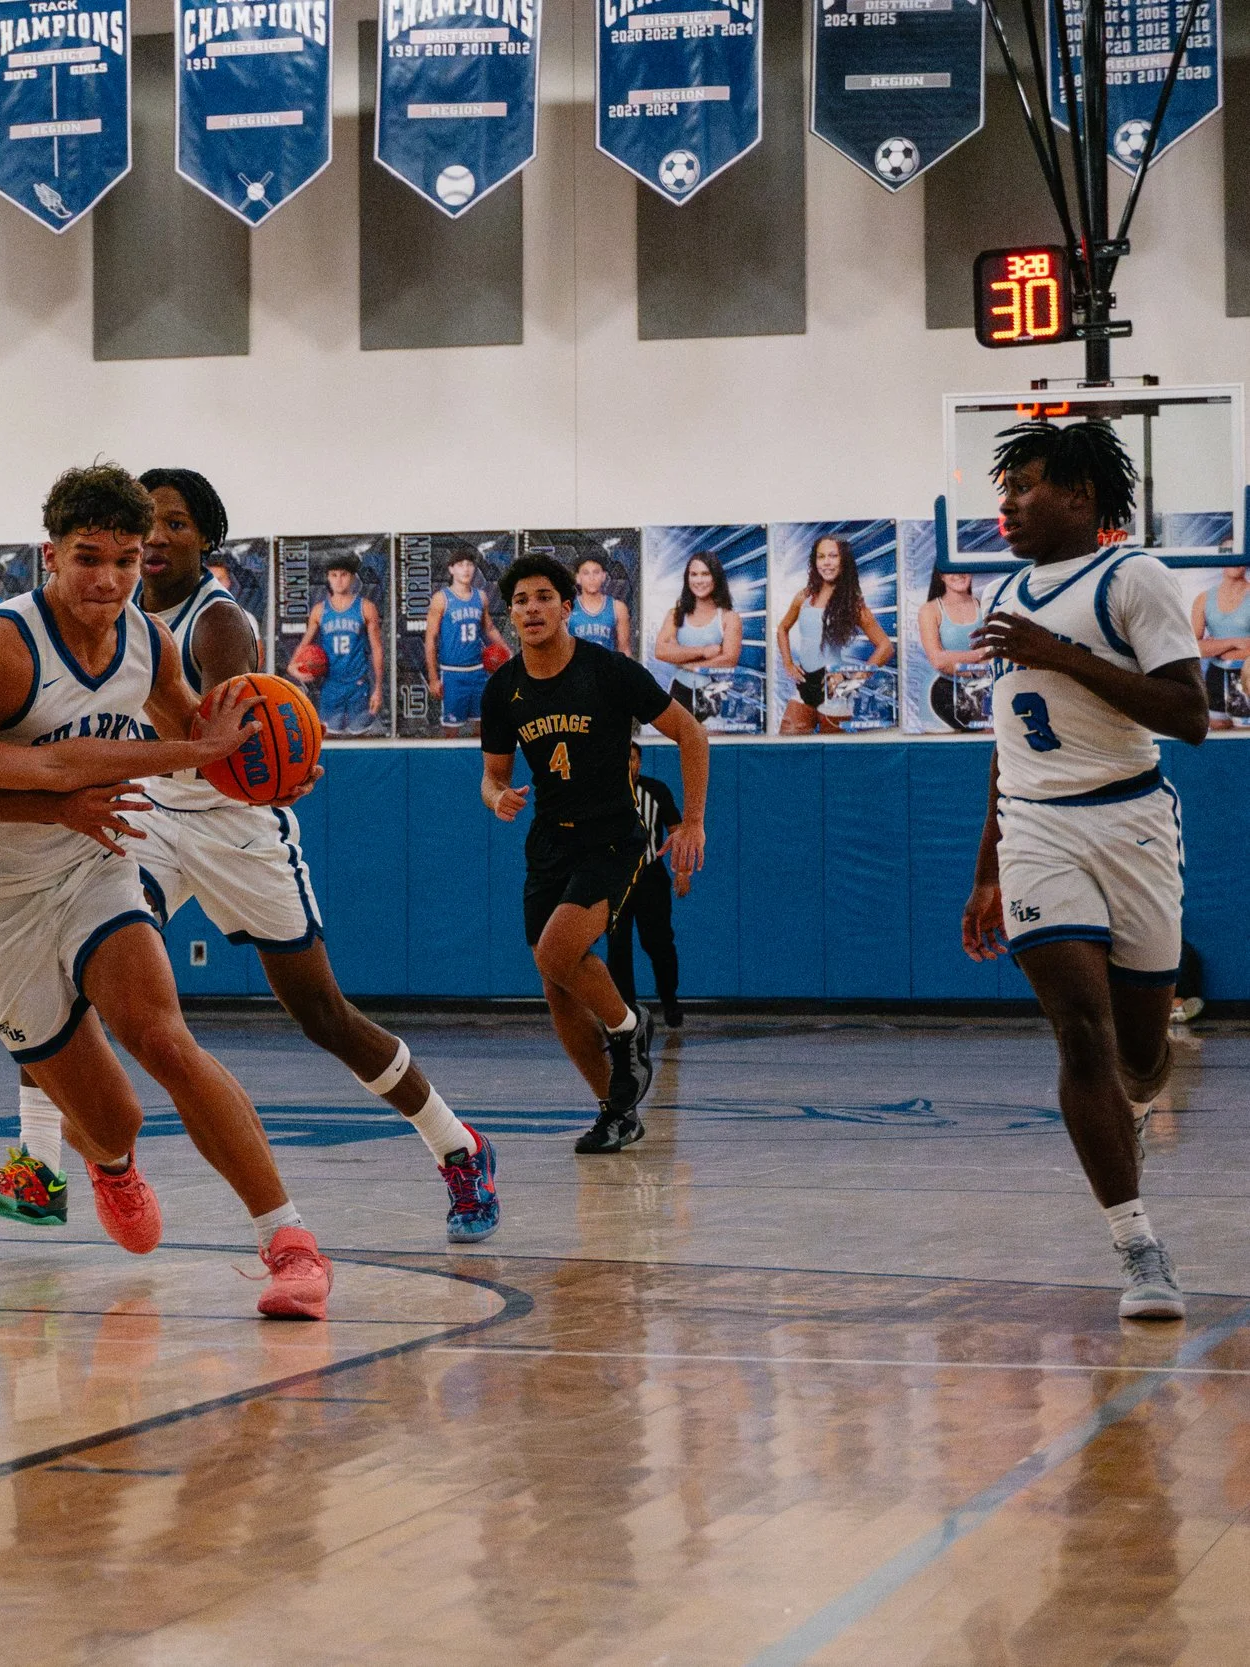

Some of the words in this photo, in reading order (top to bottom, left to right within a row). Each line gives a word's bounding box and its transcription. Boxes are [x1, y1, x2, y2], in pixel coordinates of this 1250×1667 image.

[30, 0, 78, 13] TRACK
[864, 0, 932, 10] DISTRICT
[644, 14, 712, 27] DISTRICT
[824, 14, 856, 27] 2024
[863, 12, 896, 26] 2025
[1136, 6, 1169, 22] 2005
[184, 1, 326, 55] CHAMPIONS
[611, 30, 643, 43] 2020
[645, 28, 677, 41] 2022
[683, 26, 714, 38] 2023
[720, 22, 753, 36] 2024
[1136, 22, 1170, 37] 2012
[426, 31, 492, 42] DISTRICT
[1137, 37, 1170, 52] 2022
[1186, 34, 1210, 49] 023
[222, 41, 286, 52] DISTRICT
[388, 45, 419, 58] 1991
[424, 44, 456, 56] 2010
[462, 43, 493, 55] 2011
[499, 42, 530, 54] 2012
[24, 50, 86, 63] DISTRICT
[70, 62, 108, 75] GIRLS
[186, 58, 216, 71] 1991
[4, 69, 37, 81] BOYS
[1176, 66, 1211, 80] 2020
[870, 76, 924, 87] REGION
[652, 89, 704, 102] REGION
[430, 106, 483, 116] REGION
[608, 105, 640, 118] 2023
[646, 103, 678, 116] 2024
[229, 115, 280, 126] REGION
[30, 123, 81, 134] REGION
[1007, 254, 1050, 280] 3:28
[991, 278, 1059, 340] 30
[286, 541, 310, 618] DANIEL
[460, 623, 476, 642] 13
[334, 636, 350, 654] 12
[518, 714, 592, 744] HERITAGE
[1011, 692, 1062, 752] 3
[278, 702, 305, 764] NCAA
[549, 742, 570, 780] 4
[1019, 906, 1040, 922] US
[9, 1028, 26, 1042] US
